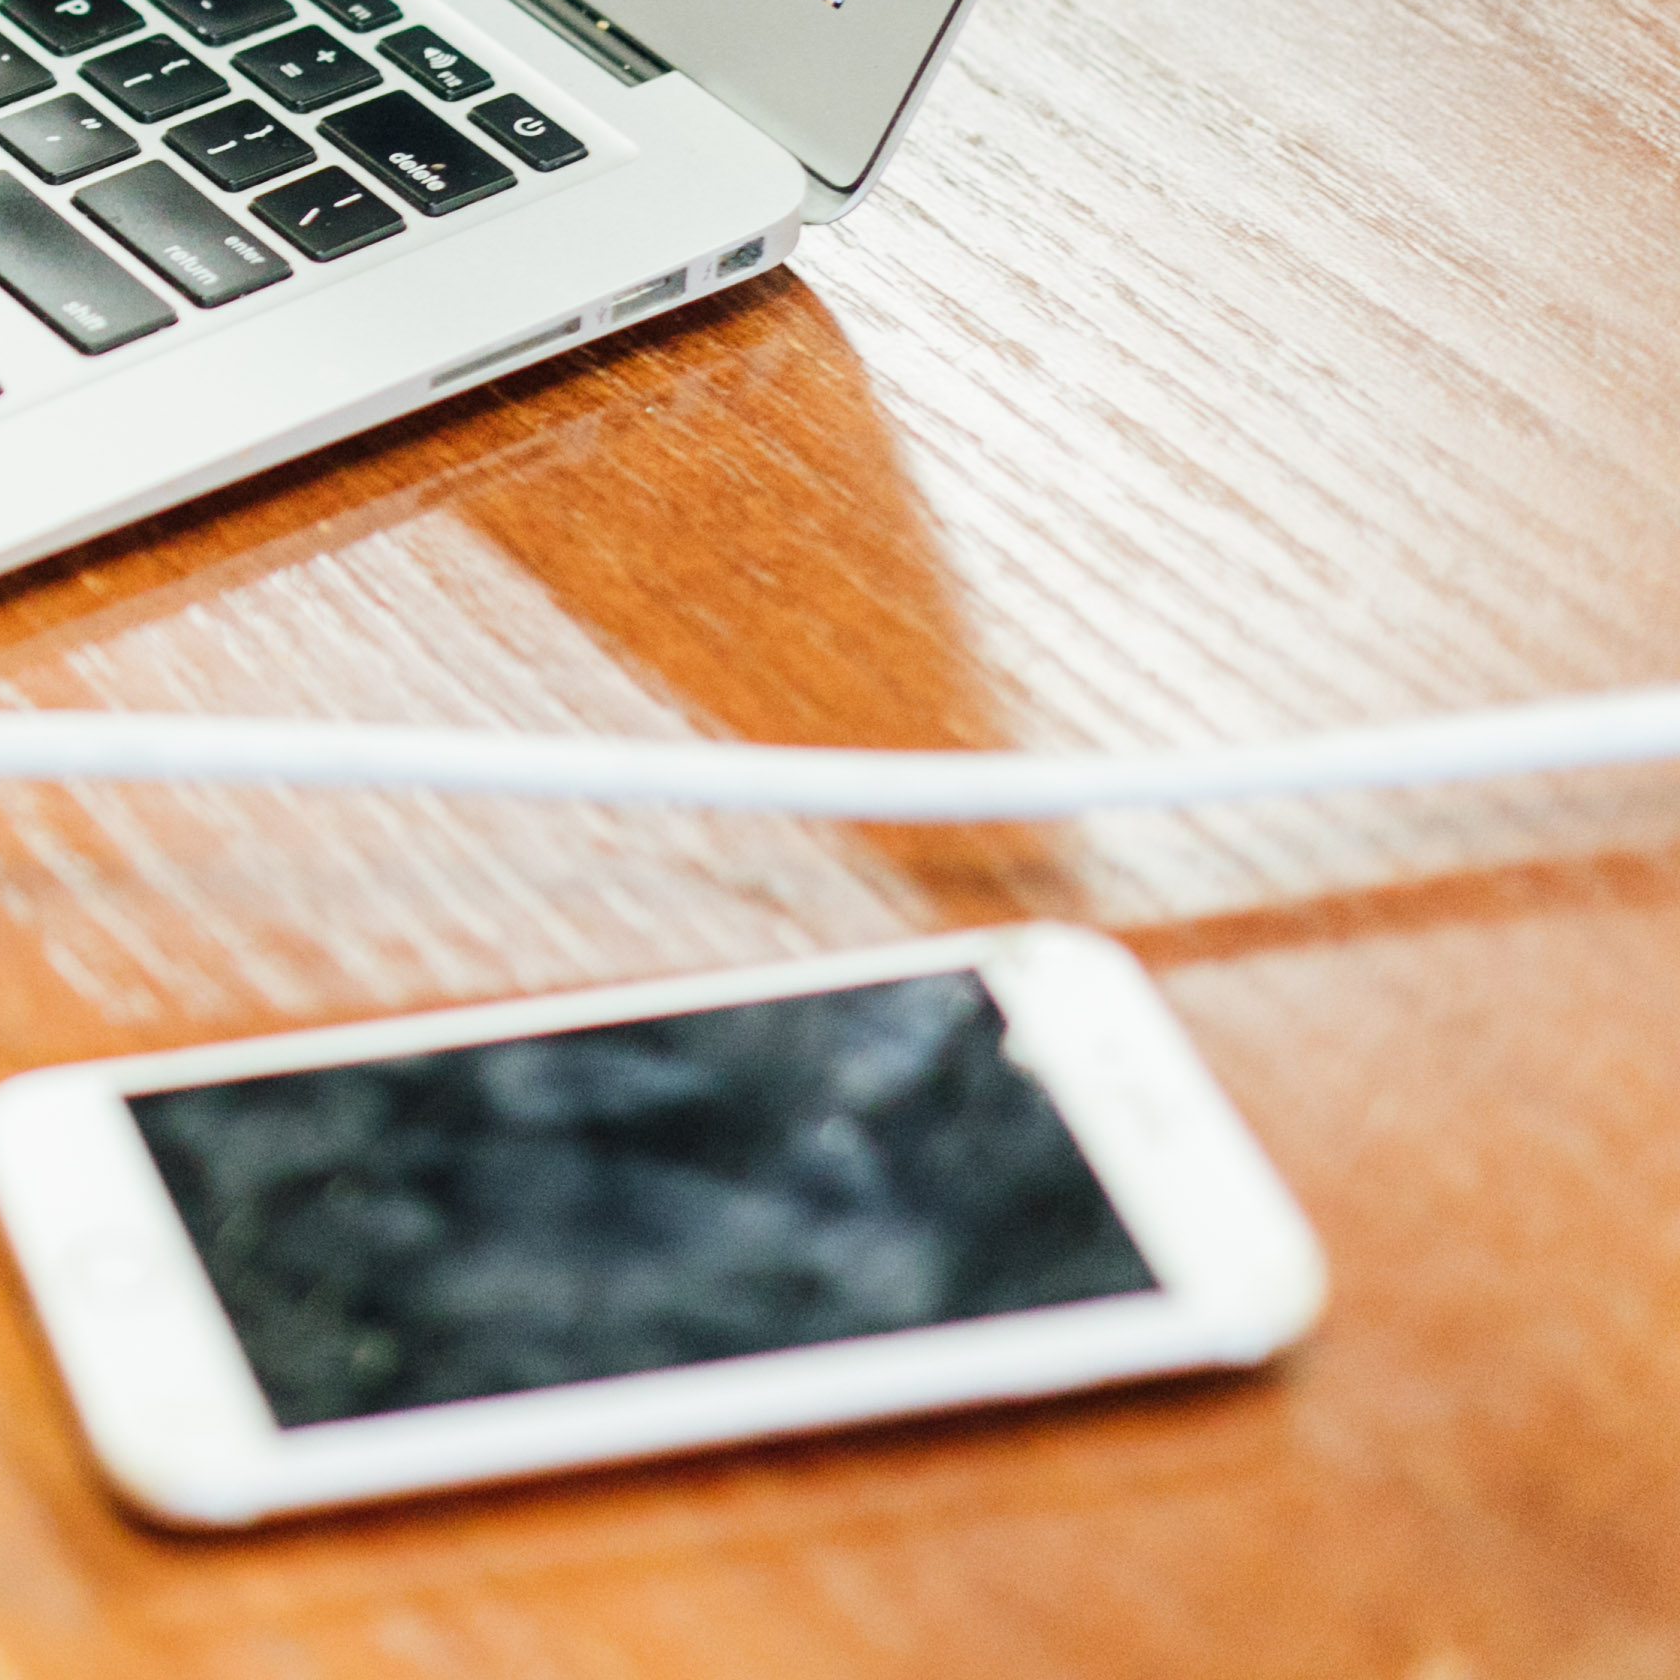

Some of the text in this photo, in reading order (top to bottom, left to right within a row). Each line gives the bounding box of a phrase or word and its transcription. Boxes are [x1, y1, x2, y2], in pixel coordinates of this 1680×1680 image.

[348, 4, 373, 20] F11
[437, 70, 465, 88] F12
[387, 151, 447, 192] delete
[163, 243, 220, 287] return
[224, 235, 267, 265] enter
[61, 301, 110, 333] shift
